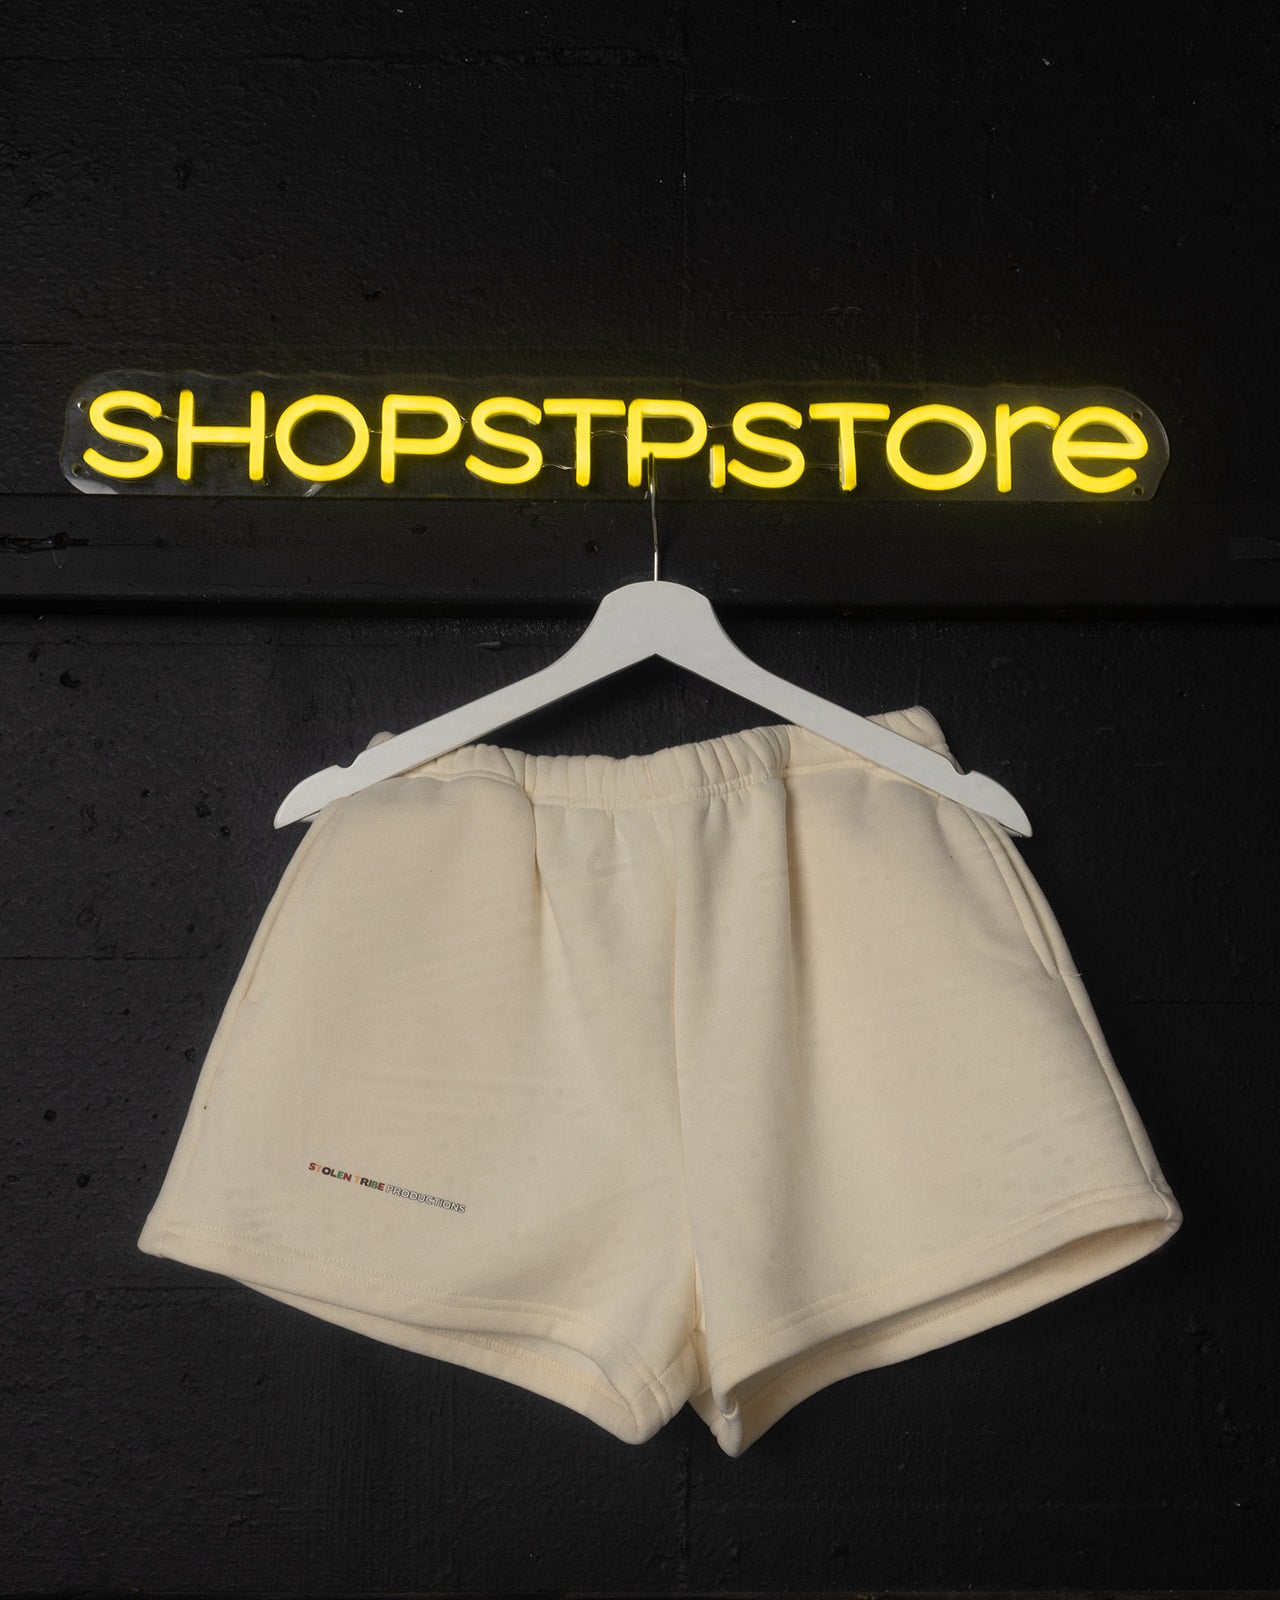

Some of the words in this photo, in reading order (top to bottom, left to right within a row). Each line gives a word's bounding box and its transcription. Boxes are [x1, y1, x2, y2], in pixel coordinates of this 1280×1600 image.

[308, 1162, 352, 1182] STOLEN
[354, 1175, 385, 1191] TRIBE
[385, 1184, 466, 1214] PRODUCTIONS
